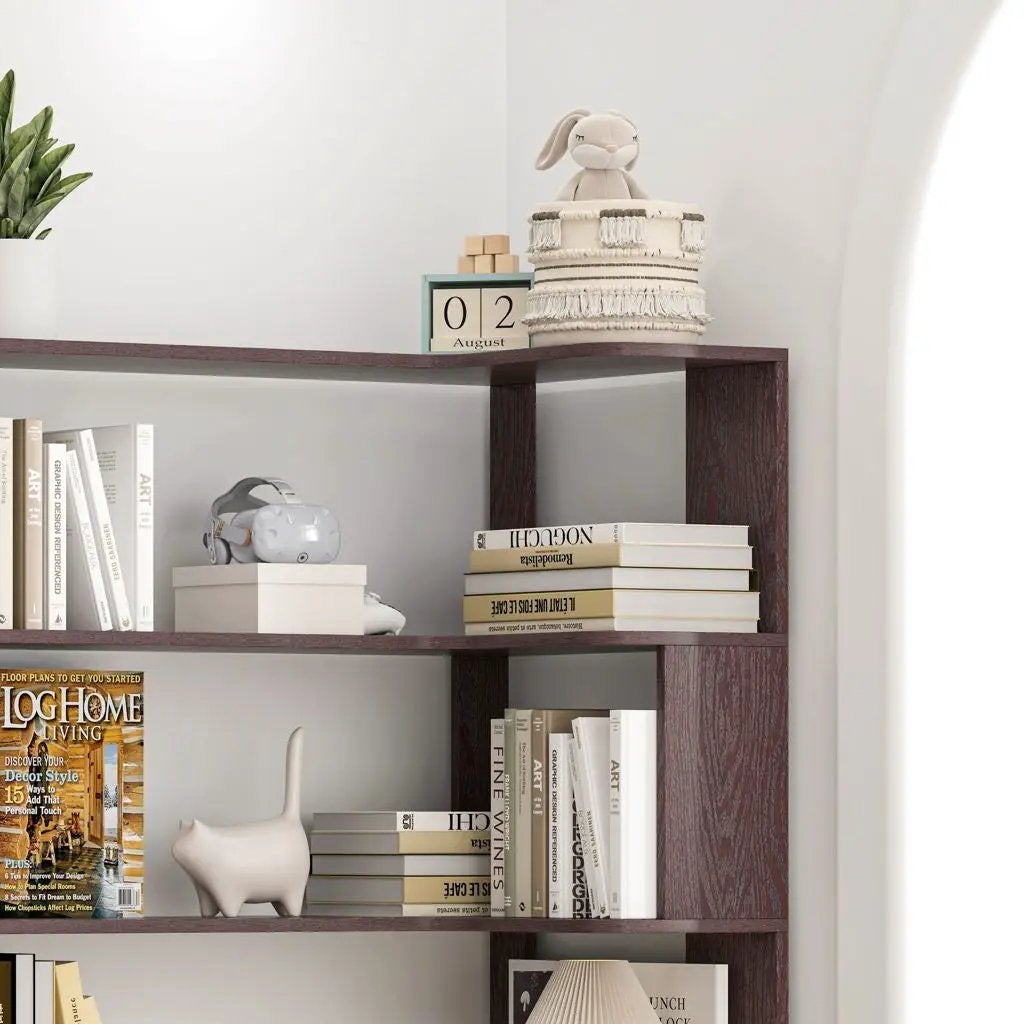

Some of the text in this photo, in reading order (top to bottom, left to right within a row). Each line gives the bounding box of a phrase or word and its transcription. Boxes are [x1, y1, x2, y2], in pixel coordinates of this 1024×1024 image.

[453, 338, 505, 349] August
[510, 526, 593, 548] NOGUCHI
[520, 554, 573, 567] Remodelista
[2, 673, 140, 683] FLOOR PLANS TO GET YOU STARTED
[43, 726, 102, 741] LIVING
[5, 757, 64, 766] DISCOVER YOUR
[4, 770, 79, 785] Decor Style
[533, 760, 542, 791] ART
[611, 760, 620, 792] ART
[4, 785, 24, 804] 15
[27, 785, 45, 793] Ways
[27, 796, 59, 804] Add That
[5, 807, 61, 815] Personal Touch
[493, 746, 504, 890] FINE WINES
[5, 860, 32, 869] PLUS:
